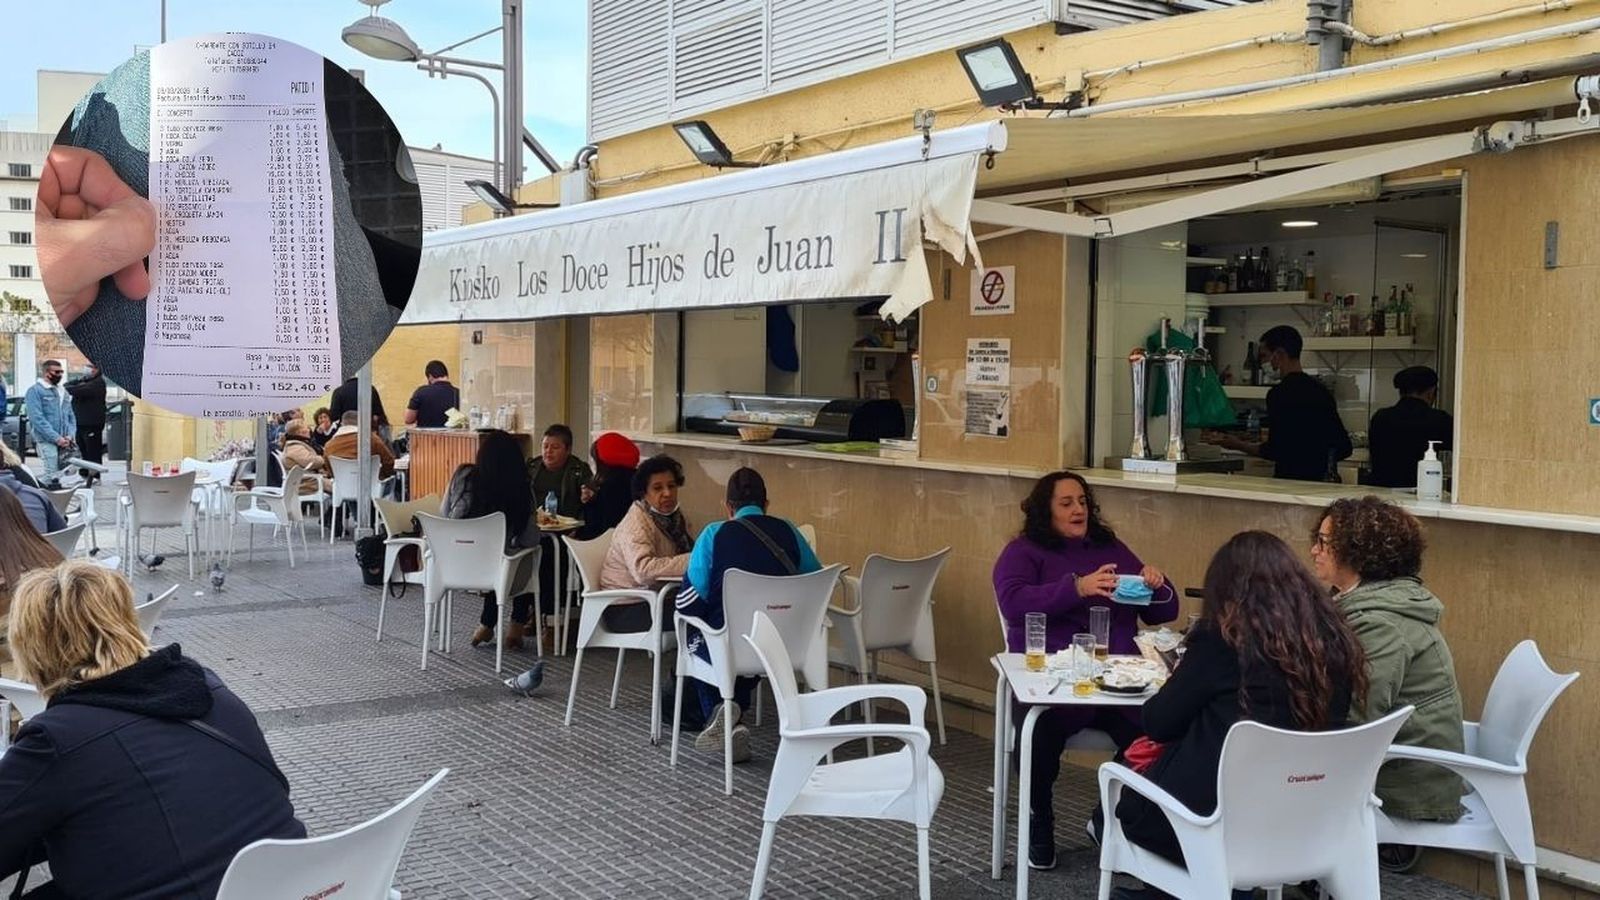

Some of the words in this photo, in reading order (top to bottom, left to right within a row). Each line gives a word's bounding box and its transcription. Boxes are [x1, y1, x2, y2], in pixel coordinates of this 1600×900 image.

[290, 81, 310, 94] PATIO
[311, 82, 315, 94] 1
[449, 265, 500, 302] Kiosko
[517, 260, 547, 297] Los
[561, 253, 609, 293] Doce
[627, 241, 685, 295] Hijos
[703, 233, 735, 279] de
[757, 225, 834, 274] Juan
[871, 207, 908, 265] II
[217, 380, 261, 390] Total:
[324, 384, 331, 392] €
